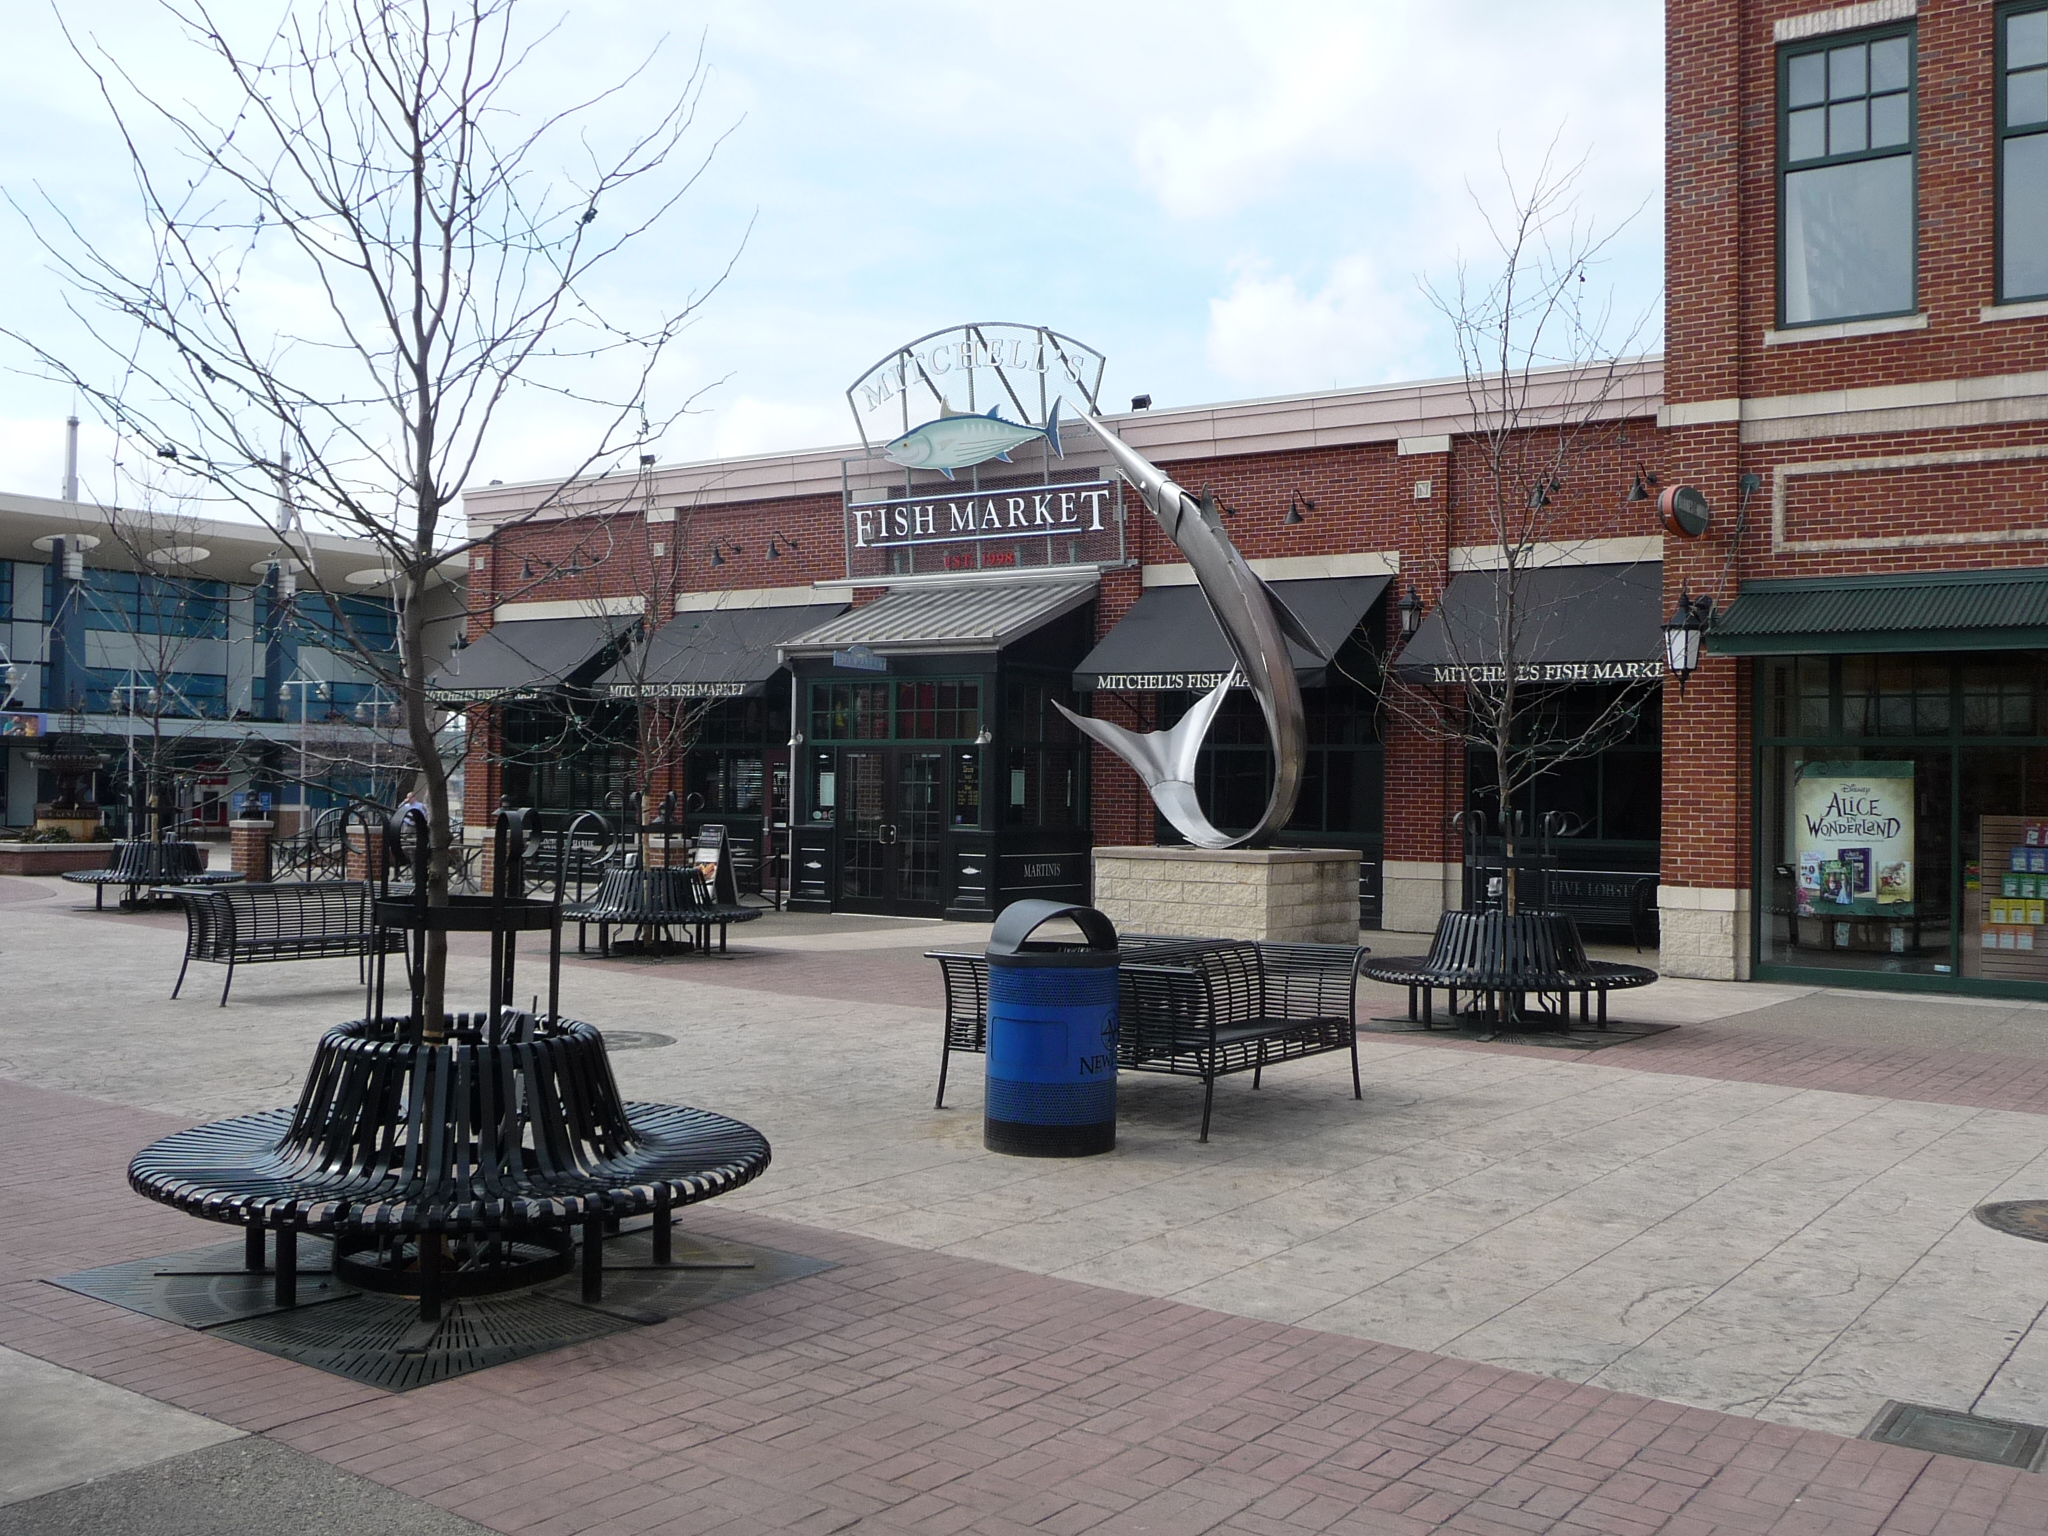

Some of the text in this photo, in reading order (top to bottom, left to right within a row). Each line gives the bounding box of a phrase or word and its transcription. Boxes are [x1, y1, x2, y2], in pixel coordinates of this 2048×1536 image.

[859, 337, 1085, 412] MITCHELL'S
[853, 489, 1110, 547] FISH MARKET
[982, 550, 1015, 567] 1998
[1433, 662, 1664, 683] MITCHEL'S FISH MARKE
[1096, 674, 1185, 690] MITCHELL'S
[1187, 673, 1222, 688] FISH
[609, 683, 747, 698] MITCELL'S FISH MARKET
[1023, 863, 1061, 878] MARTINIS
